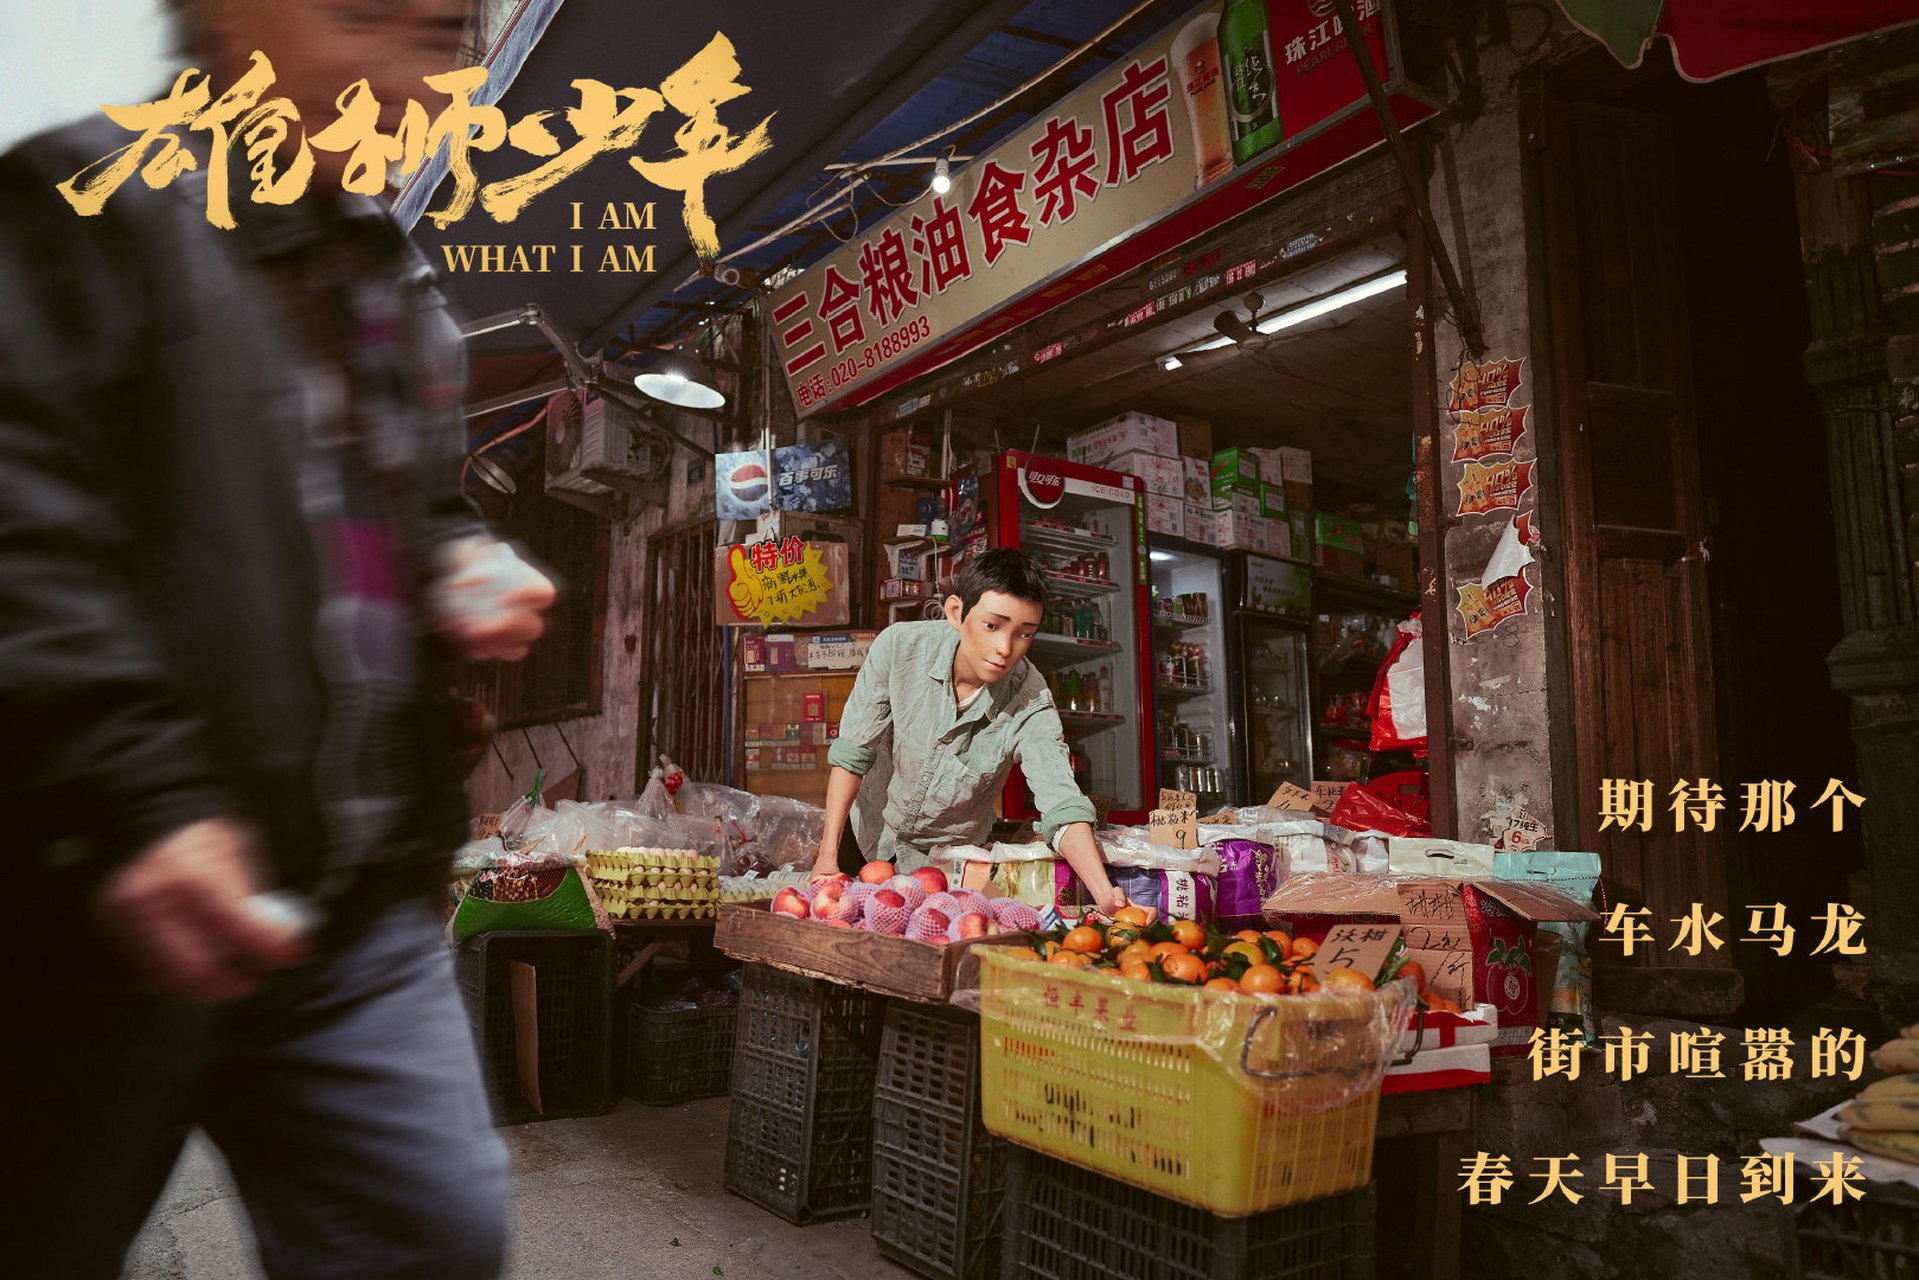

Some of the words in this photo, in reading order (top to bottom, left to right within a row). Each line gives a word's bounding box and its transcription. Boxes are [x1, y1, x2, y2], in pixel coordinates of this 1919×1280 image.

[1284, 0, 1381, 65] 珠江酒
[1296, 49, 1335, 76] PEARL
[771, 55, 1174, 376] 三合粮油食杂店
[778, 464, 839, 487] 百事可乐
[1028, 471, 1061, 488] 可口可乐
[1091, 485, 1106, 496] ICE
[1108, 488, 1131, 499] COLD
[750, 535, 806, 574] 特价
[1175, 829, 1187, 849] 9
[1330, 928, 1388, 943] 沃柑
[1328, 947, 1360, 968] 5
[1043, 983, 1136, 1031] 恒丰果业
